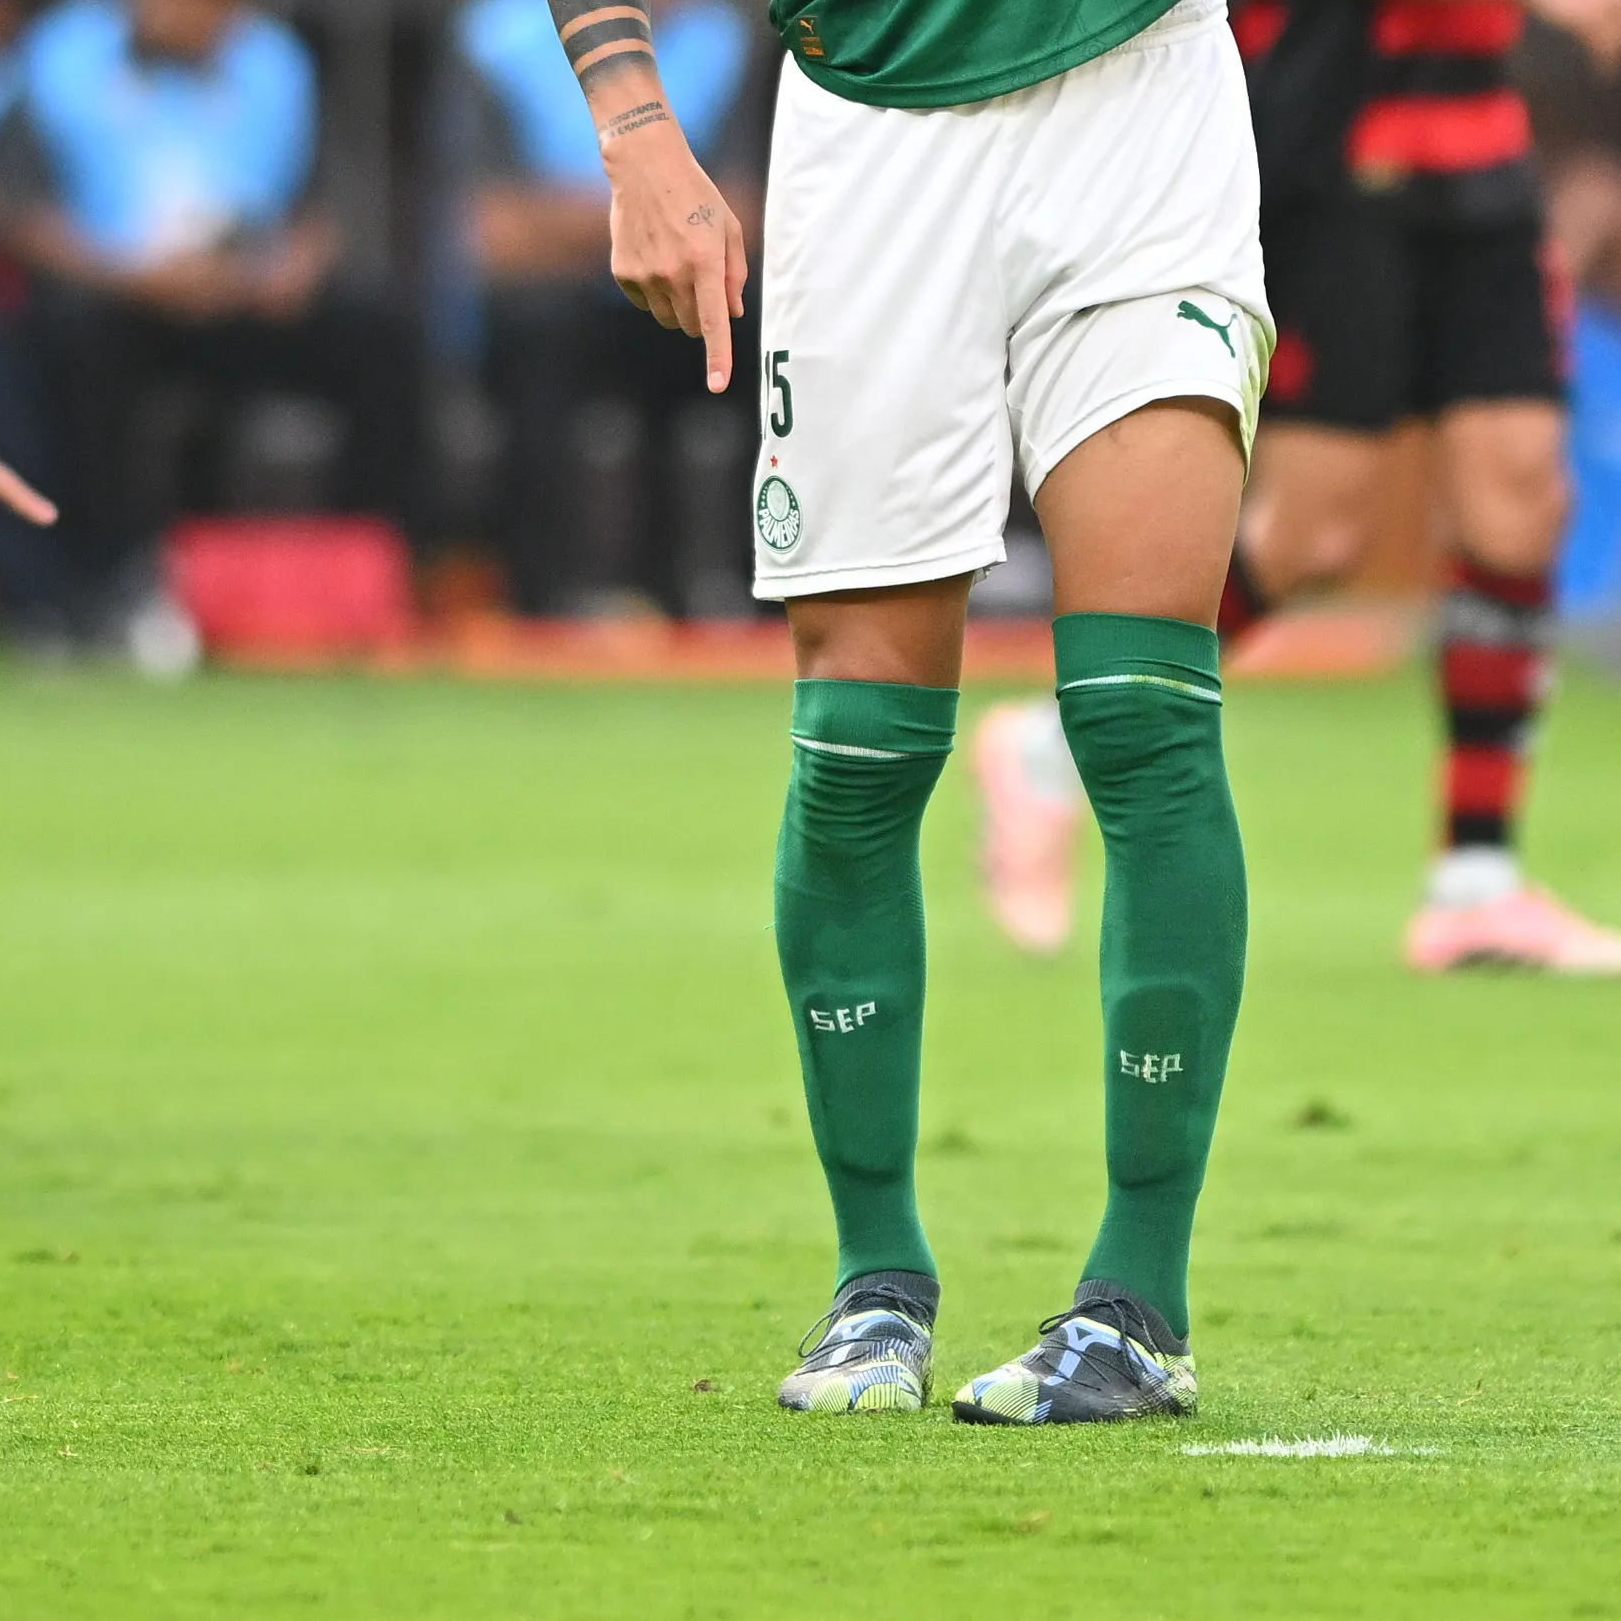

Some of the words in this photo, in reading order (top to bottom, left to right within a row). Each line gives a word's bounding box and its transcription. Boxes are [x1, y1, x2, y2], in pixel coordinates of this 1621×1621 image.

[758, 508, 800, 548] PALMEIRAS
[810, 1001, 876, 1034] SEP
[1120, 1049, 1184, 1084] SEP
